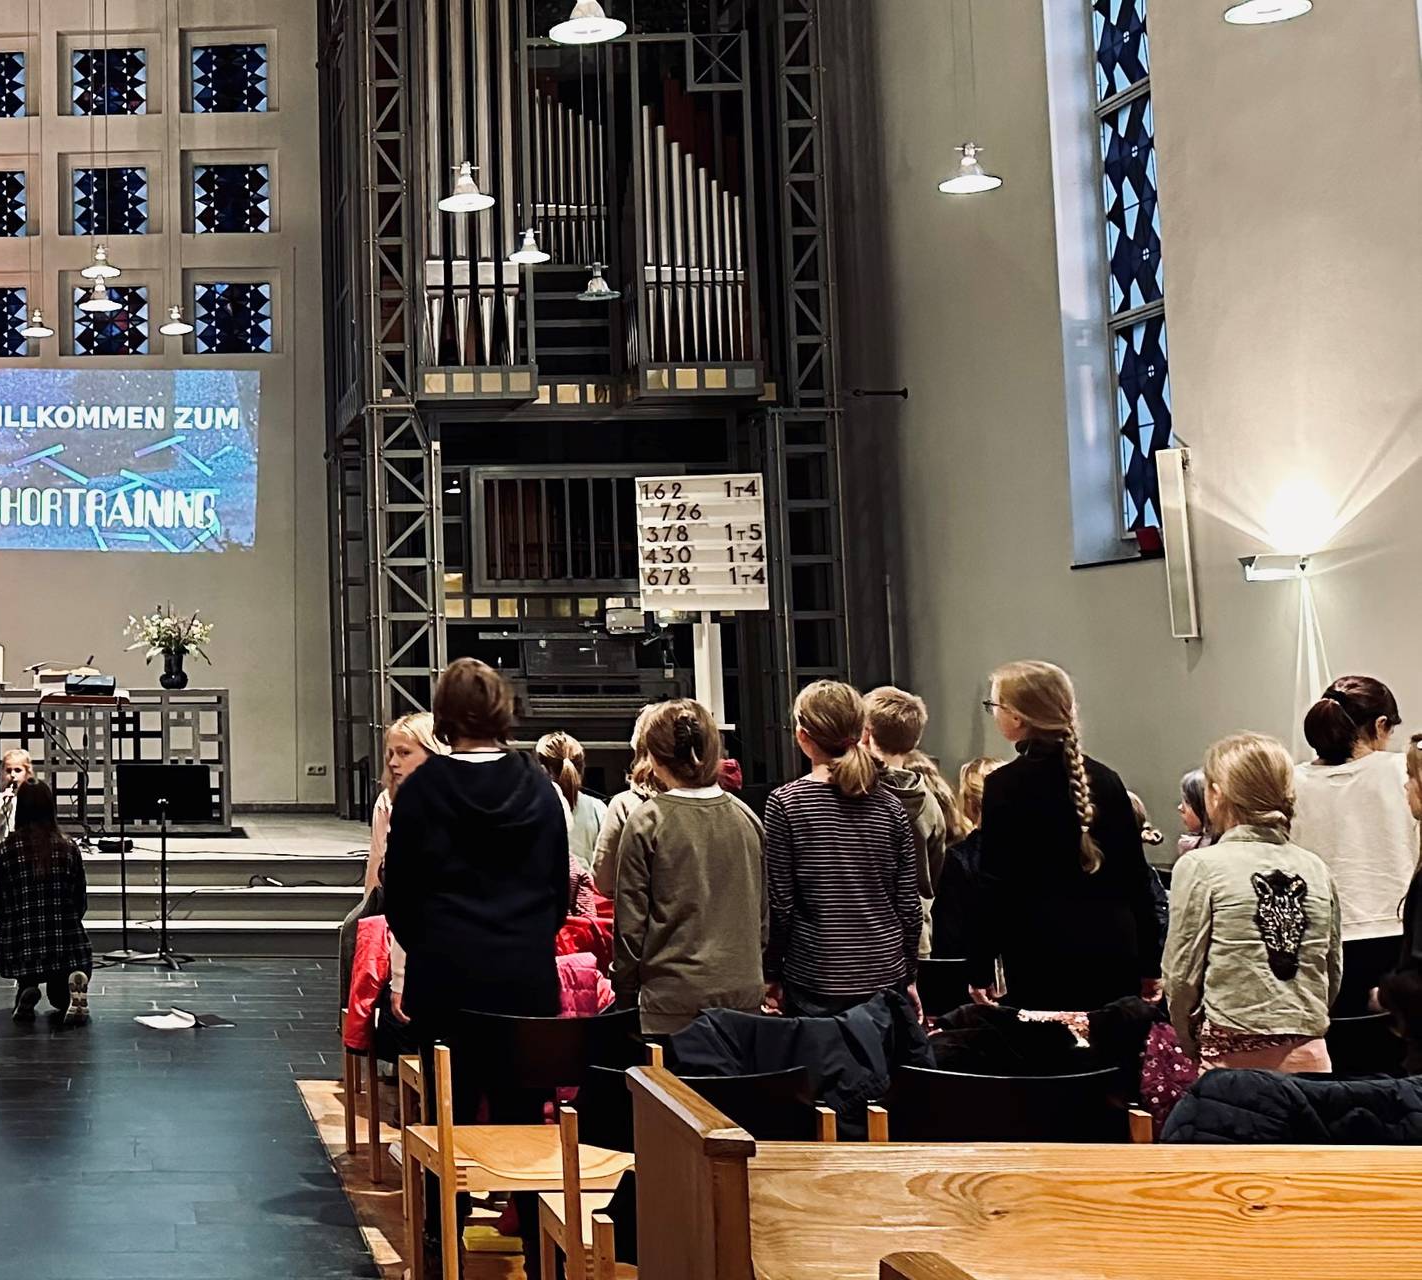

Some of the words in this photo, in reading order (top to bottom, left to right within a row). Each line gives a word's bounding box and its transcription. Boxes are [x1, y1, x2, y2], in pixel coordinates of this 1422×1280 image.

[173, 405, 240, 431] ZUM
[642, 482, 682, 500] 162
[660, 503, 702, 521] 726
[646, 525, 688, 543] 378
[645, 546, 692, 564] 430
[647, 568, 691, 586] 678
